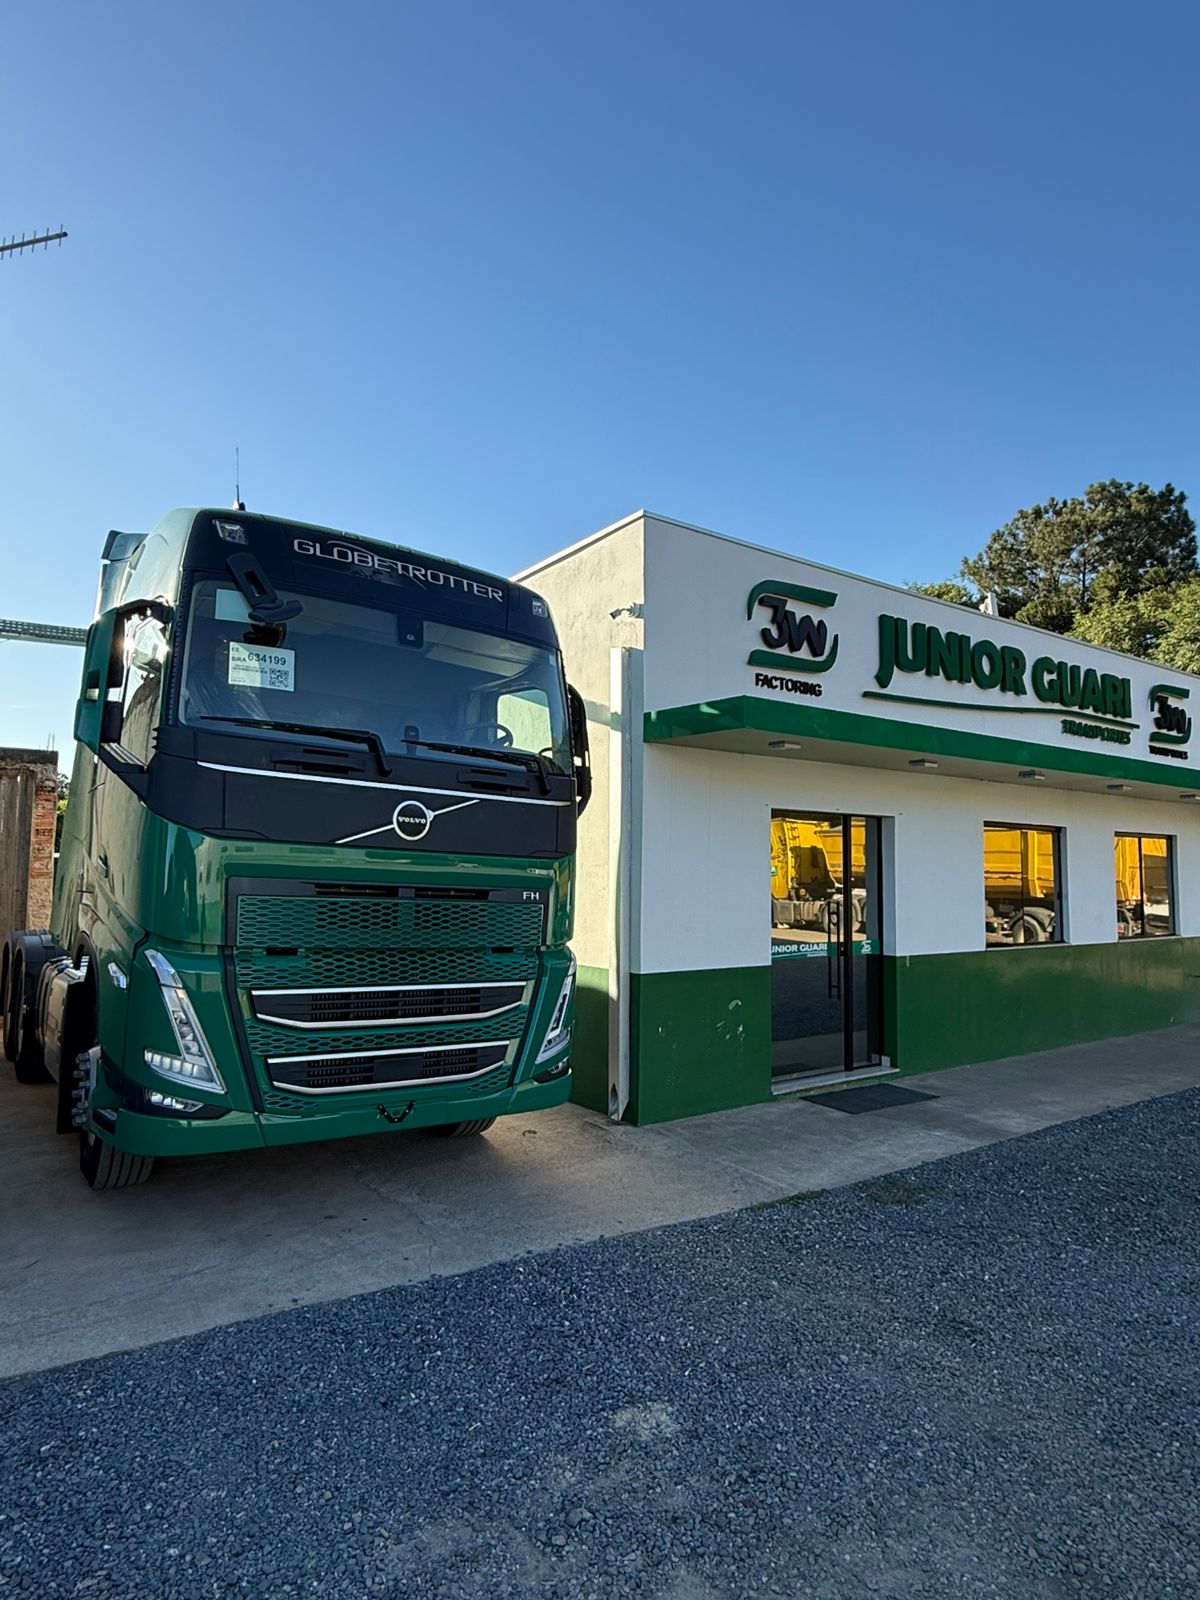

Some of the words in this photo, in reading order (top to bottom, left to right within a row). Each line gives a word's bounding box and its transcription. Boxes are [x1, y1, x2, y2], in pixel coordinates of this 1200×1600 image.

[293, 539, 504, 602] GLOBETROTTER
[758, 595, 828, 658] 3W
[247, 652, 287, 666] 634199
[874, 613, 1028, 696] JUNIOR
[1031, 655, 1133, 719] GUARI
[755, 673, 823, 697] FACTORING
[398, 816, 427, 825] VOLVO
[523, 891, 540, 901] FH
[770, 944, 799, 954] UNIOR
[799, 943, 828, 952] GUARI
